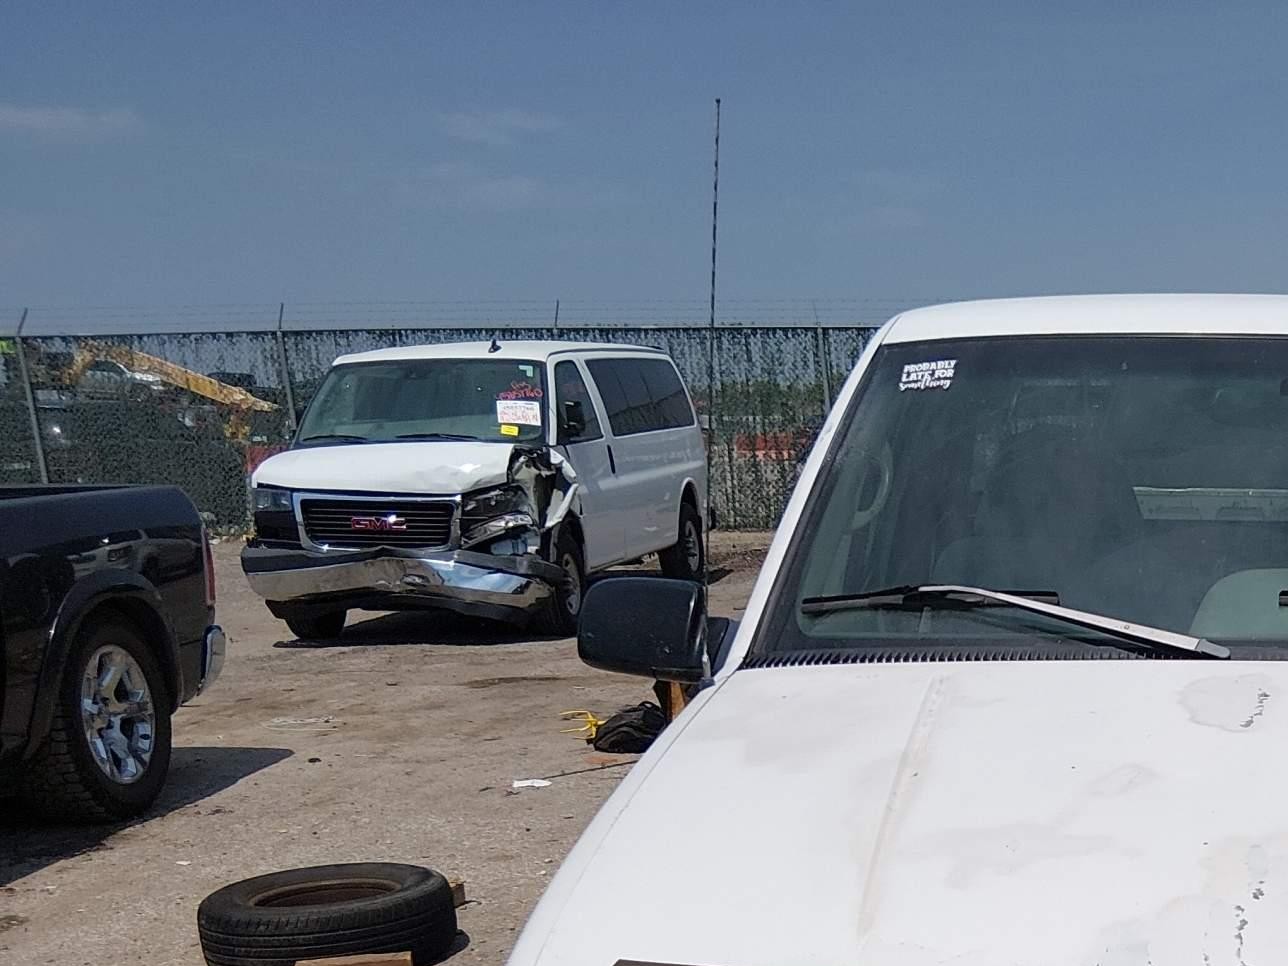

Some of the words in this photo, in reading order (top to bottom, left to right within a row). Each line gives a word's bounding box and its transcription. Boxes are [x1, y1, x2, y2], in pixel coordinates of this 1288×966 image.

[903, 360, 957, 374] PROBABLY
[901, 371, 932, 382] LATE
[934, 369, 955, 379] FOR
[352, 515, 407, 529] GMC
